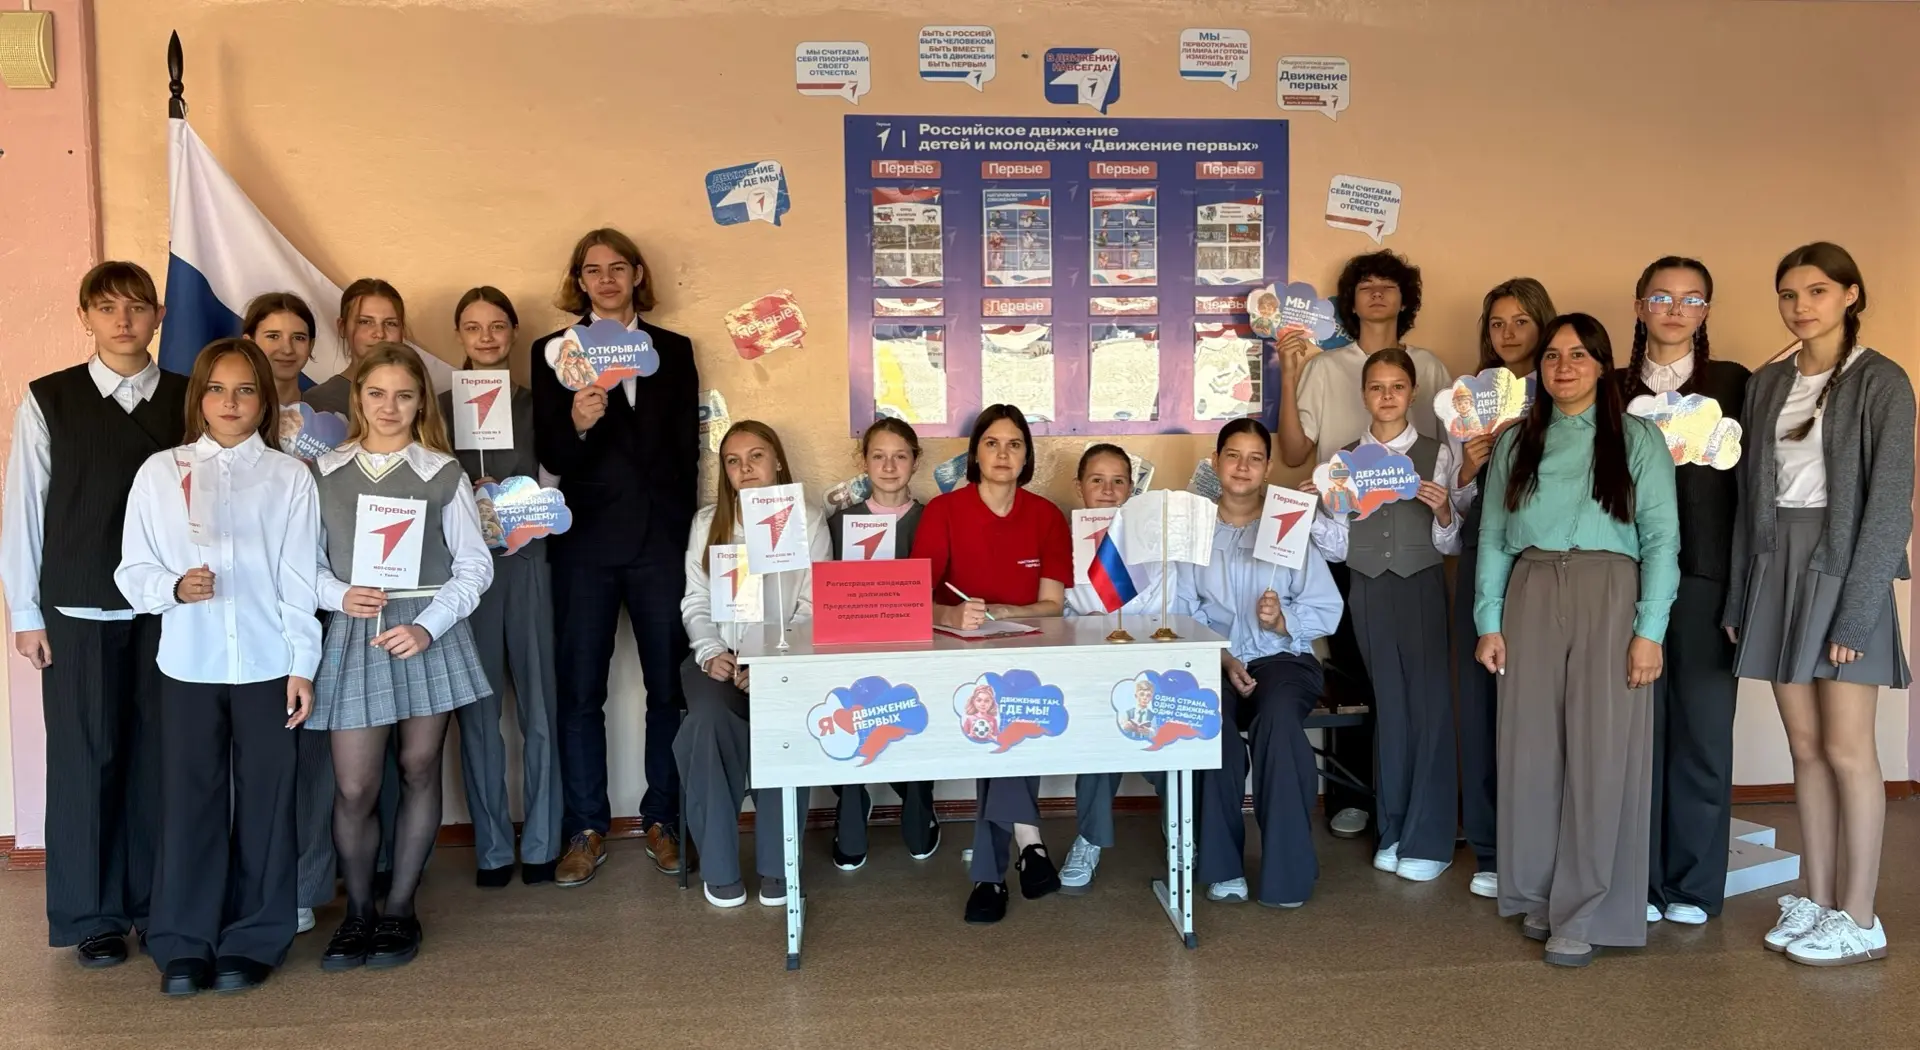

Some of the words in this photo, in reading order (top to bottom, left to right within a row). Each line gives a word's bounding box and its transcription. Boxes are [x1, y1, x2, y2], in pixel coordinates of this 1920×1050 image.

[1199, 32, 1220, 41] МЫ
[1055, 53, 1117, 62] ДВИЖЕНИИ
[1052, 63, 1111, 72] НАВСЕГДА!
[1279, 71, 1348, 82] Движение
[1289, 82, 1338, 91] первых
[919, 123, 1026, 136] Российское
[1029, 126, 1119, 138] движение
[918, 138, 971, 151] детей
[975, 142, 986, 150] и
[989, 139, 1081, 151] молодёжи
[1085, 139, 1183, 152] «Движение
[1186, 142, 1259, 153] первых»
[712, 164, 775, 184] ДВИЖЕНИЕ
[879, 162, 934, 177] Первые
[989, 163, 1043, 177] Первые
[1096, 163, 1150, 177] Первые
[1203, 163, 1256, 177] Первые
[737, 178, 758, 188] ГДЕ
[760, 174, 783, 184] МЫ!
[1341, 182, 1354, 190] МЫ
[1356, 185, 1392, 195] СЧИТАЕМ
[1330, 187, 1351, 196] СЕБЯ
[1352, 191, 1400, 204] ПИОНЕРАМИ
[1340, 203, 1386, 215] ОТЕЧЕСТВА!
[1349, 197, 1379, 208] СВОЕГО
[990, 299, 1044, 313] Первые
[1285, 295, 1311, 311] МЫ
[588, 341, 649, 355] ОТКРЫВАЙ
[589, 354, 636, 365] СТРАНУ!
[461, 378, 503, 386] Первые
[1356, 466, 1395, 479] ДЕРЗАЙ
[1397, 467, 1404, 475] И
[1356, 474, 1415, 487] ОТКРЫВАЙ!
[751, 495, 795, 505] Первые
[1273, 493, 1310, 508] Первые
[369, 504, 417, 515] Первые
[528, 505, 549, 513] МИР
[510, 512, 558, 523] ЛУЧШЕМУ!
[1081, 515, 1114, 523] Первы
[851, 521, 888, 530] Первые
[1000, 696, 1040, 704] ДВИЖЕНИЕ
[1153, 701, 1176, 710] ОДНО
[1155, 694, 1176, 703] ОДНА
[1177, 698, 1208, 708] СТРАНА,
[852, 698, 918, 721] ДВИЖЕНИЕ
[1000, 704, 1023, 715] ГДЕ
[1025, 705, 1049, 716] МЫ!
[1152, 708, 1174, 716] ОДИН
[818, 716, 835, 736] Я
[853, 713, 901, 731] ПЕРВЫХ
